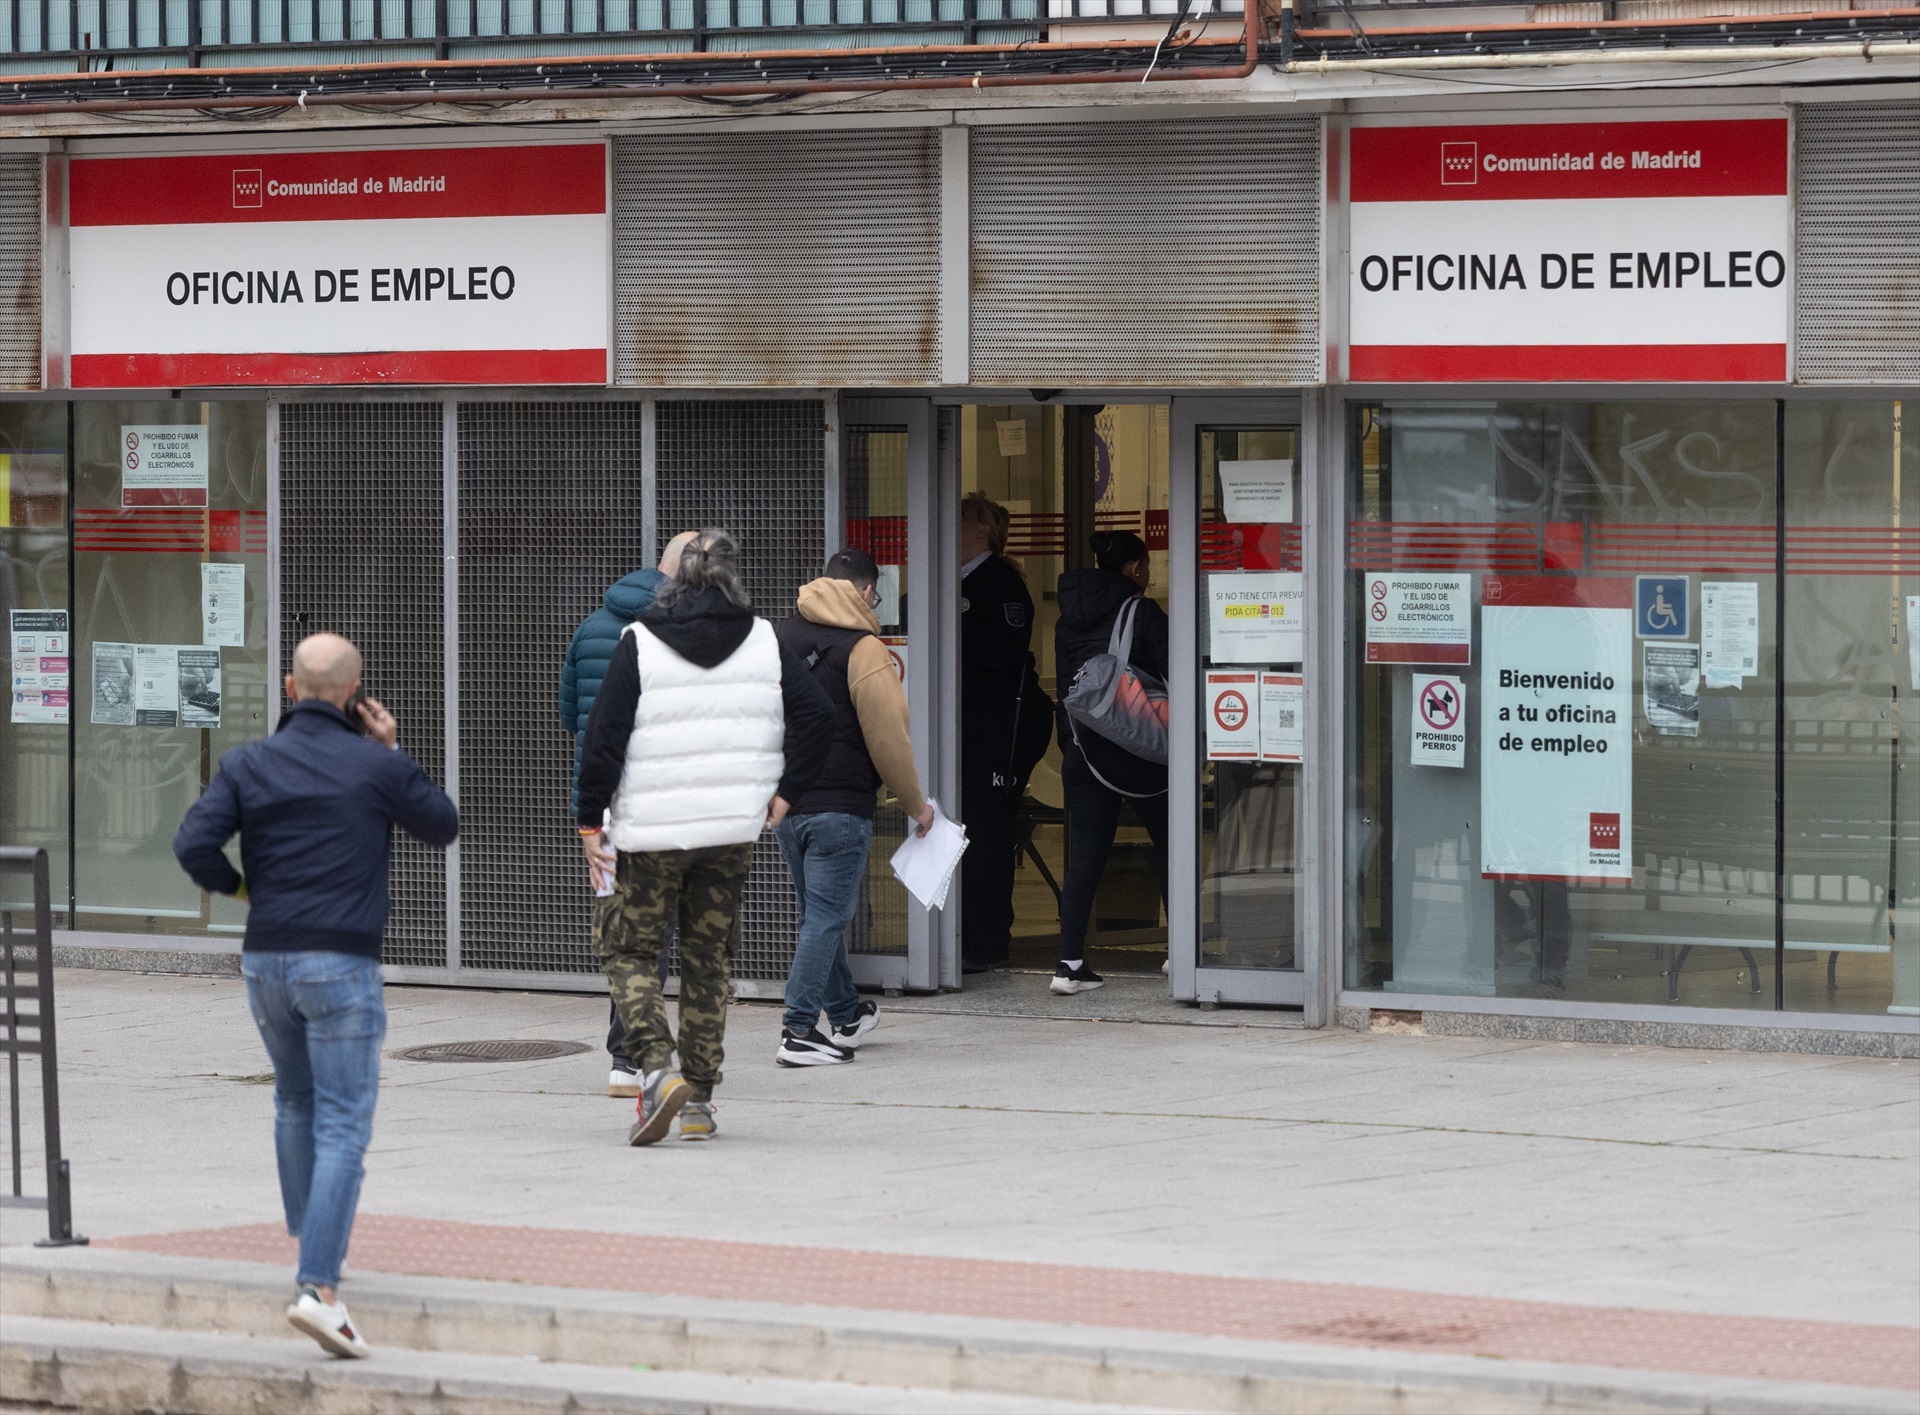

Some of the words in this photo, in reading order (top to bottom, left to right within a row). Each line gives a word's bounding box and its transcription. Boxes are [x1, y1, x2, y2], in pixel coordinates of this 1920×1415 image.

[1483, 153, 1594, 172] Comunidad
[1601, 152, 1625, 169] de
[1631, 151, 1701, 169] Madrid
[267, 179, 358, 196] Comunidad
[363, 178, 383, 194] de
[388, 176, 445, 193] Madrid
[1359, 254, 1526, 292] OFICINA
[1540, 253, 1594, 289] DE
[1609, 250, 1786, 288] EMPLEO
[166, 271, 303, 305] OFICINA
[314, 269, 359, 302] DE
[371, 266, 516, 301] EMPLEO
[1392, 582, 1432, 590] PROHIBIDO
[1398, 613, 1454, 621] ELECTRÓNICOS
[1500, 670, 1614, 690] Bienvenido
[1499, 707, 1510, 721] a
[1517, 704, 1537, 721] tu
[1546, 704, 1616, 724] oficina
[1416, 732, 1463, 742] PROHIBIDO
[1423, 742, 1456, 751] PERROS
[1499, 733, 1523, 751] de
[1531, 735, 1608, 756] empleo
